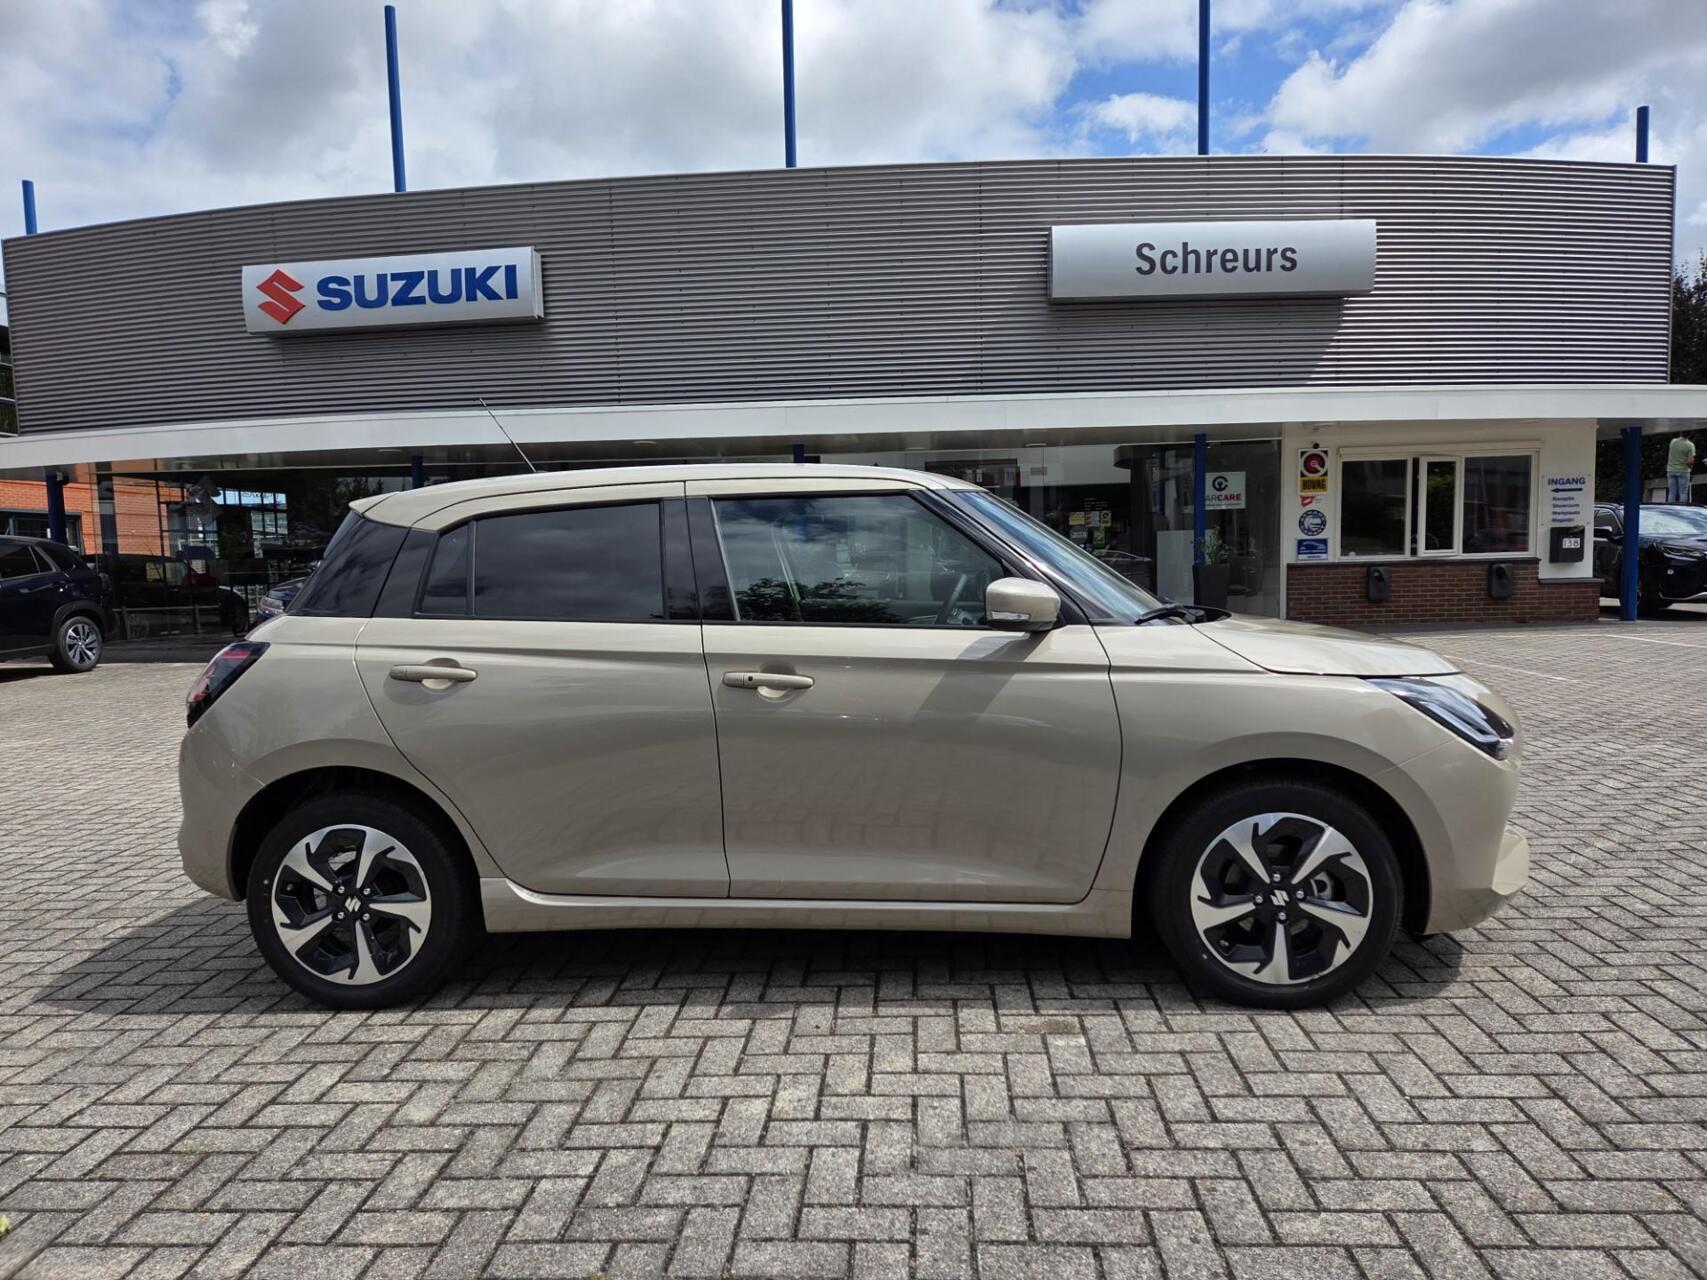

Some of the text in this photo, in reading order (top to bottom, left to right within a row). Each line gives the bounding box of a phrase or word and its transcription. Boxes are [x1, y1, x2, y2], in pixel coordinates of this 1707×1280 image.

[1135, 241, 1298, 275] Schreurs
[316, 264, 519, 311] SUZUKI
[1547, 476, 1586, 486] INGANG
